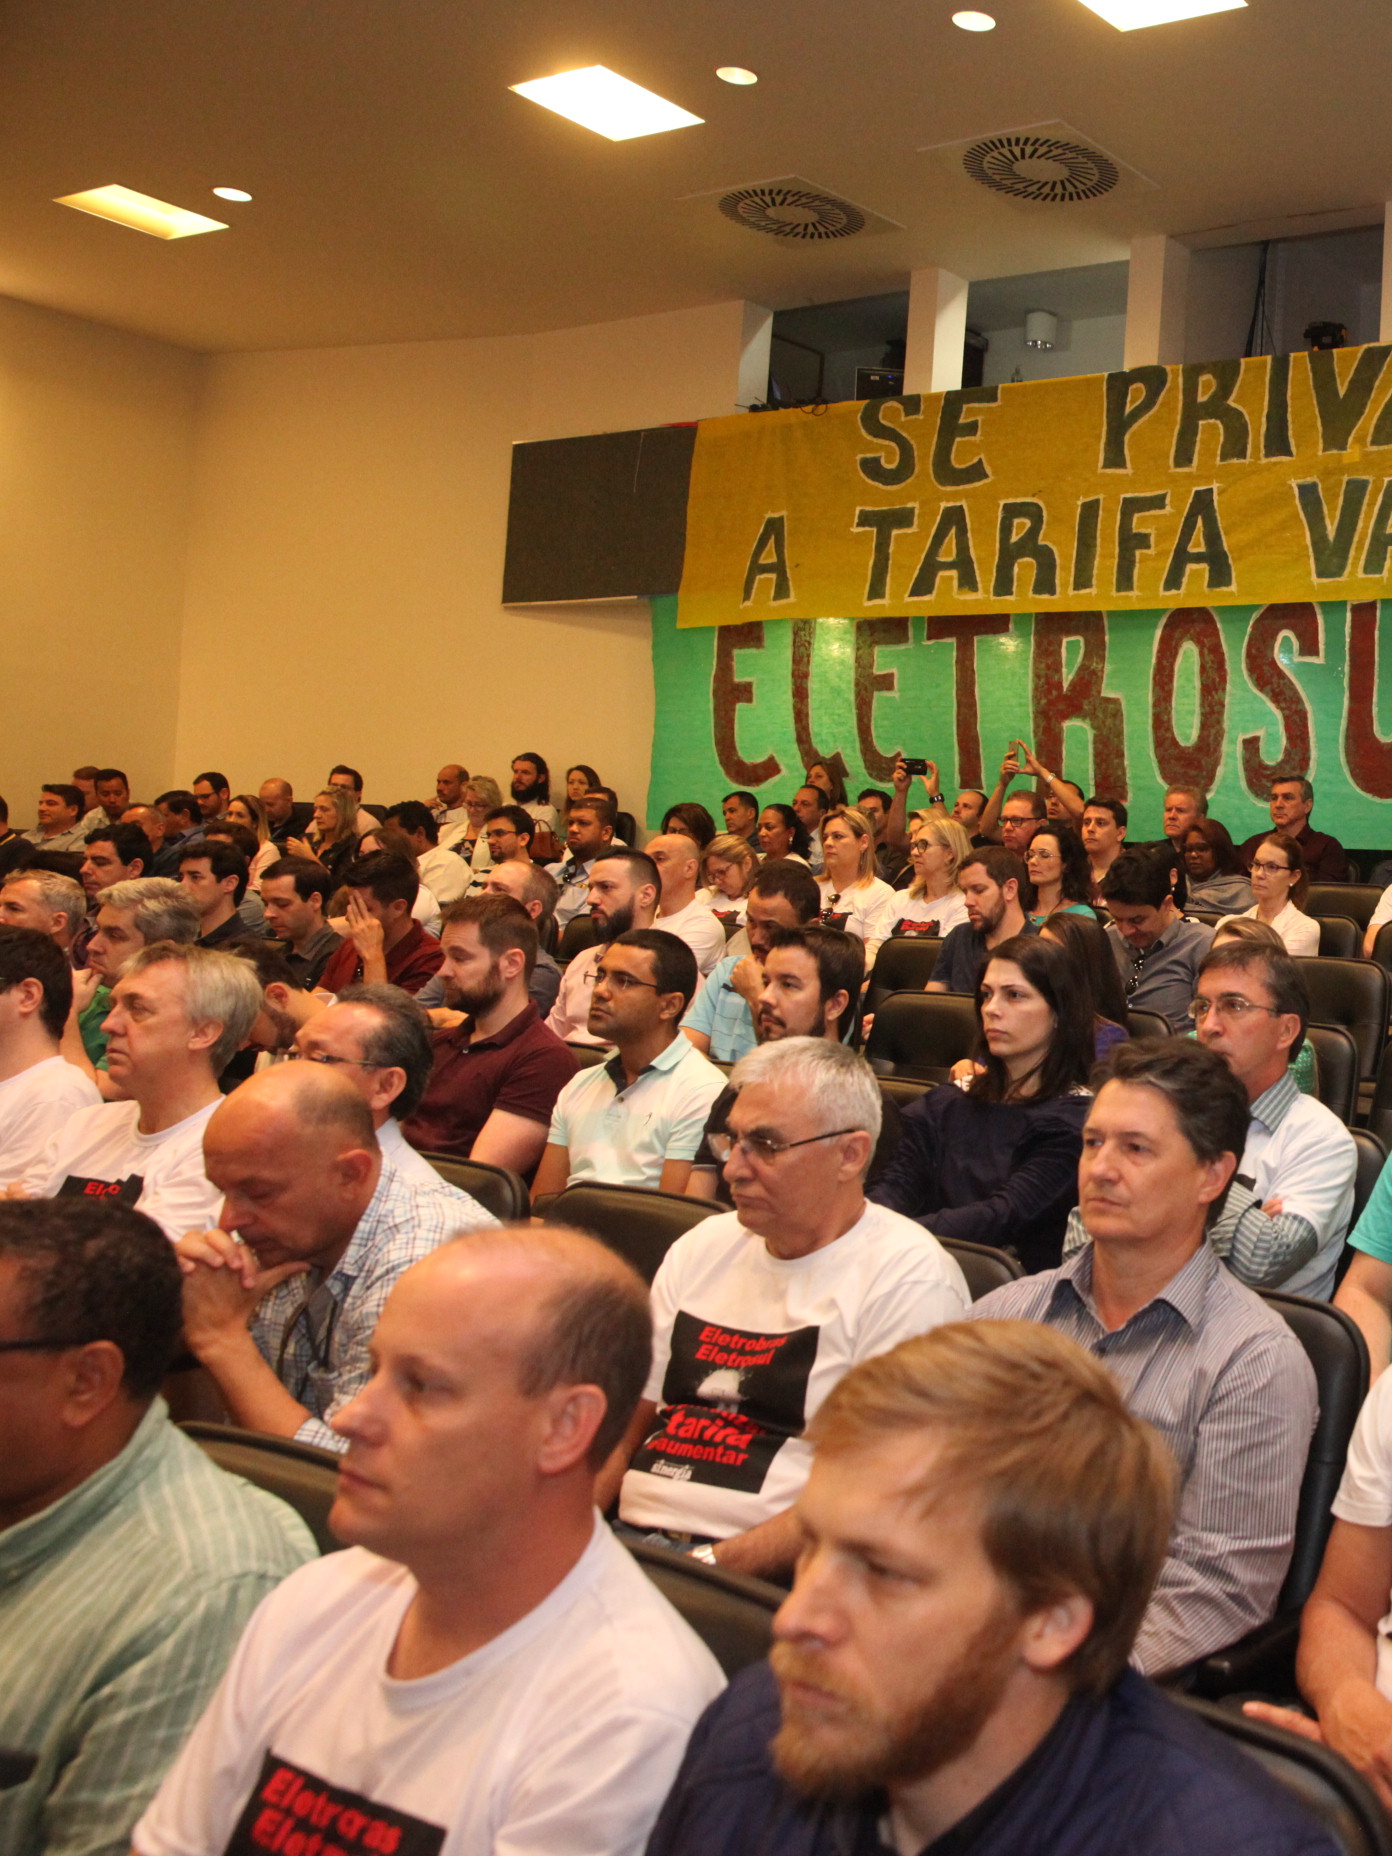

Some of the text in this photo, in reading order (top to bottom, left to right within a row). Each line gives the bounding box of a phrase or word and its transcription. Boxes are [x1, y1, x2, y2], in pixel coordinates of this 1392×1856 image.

[856, 390, 1000, 489] SE
[741, 510, 795, 606] A
[853, 481, 1238, 605] TARIFA
[656, 1437, 750, 1467] aumentar
